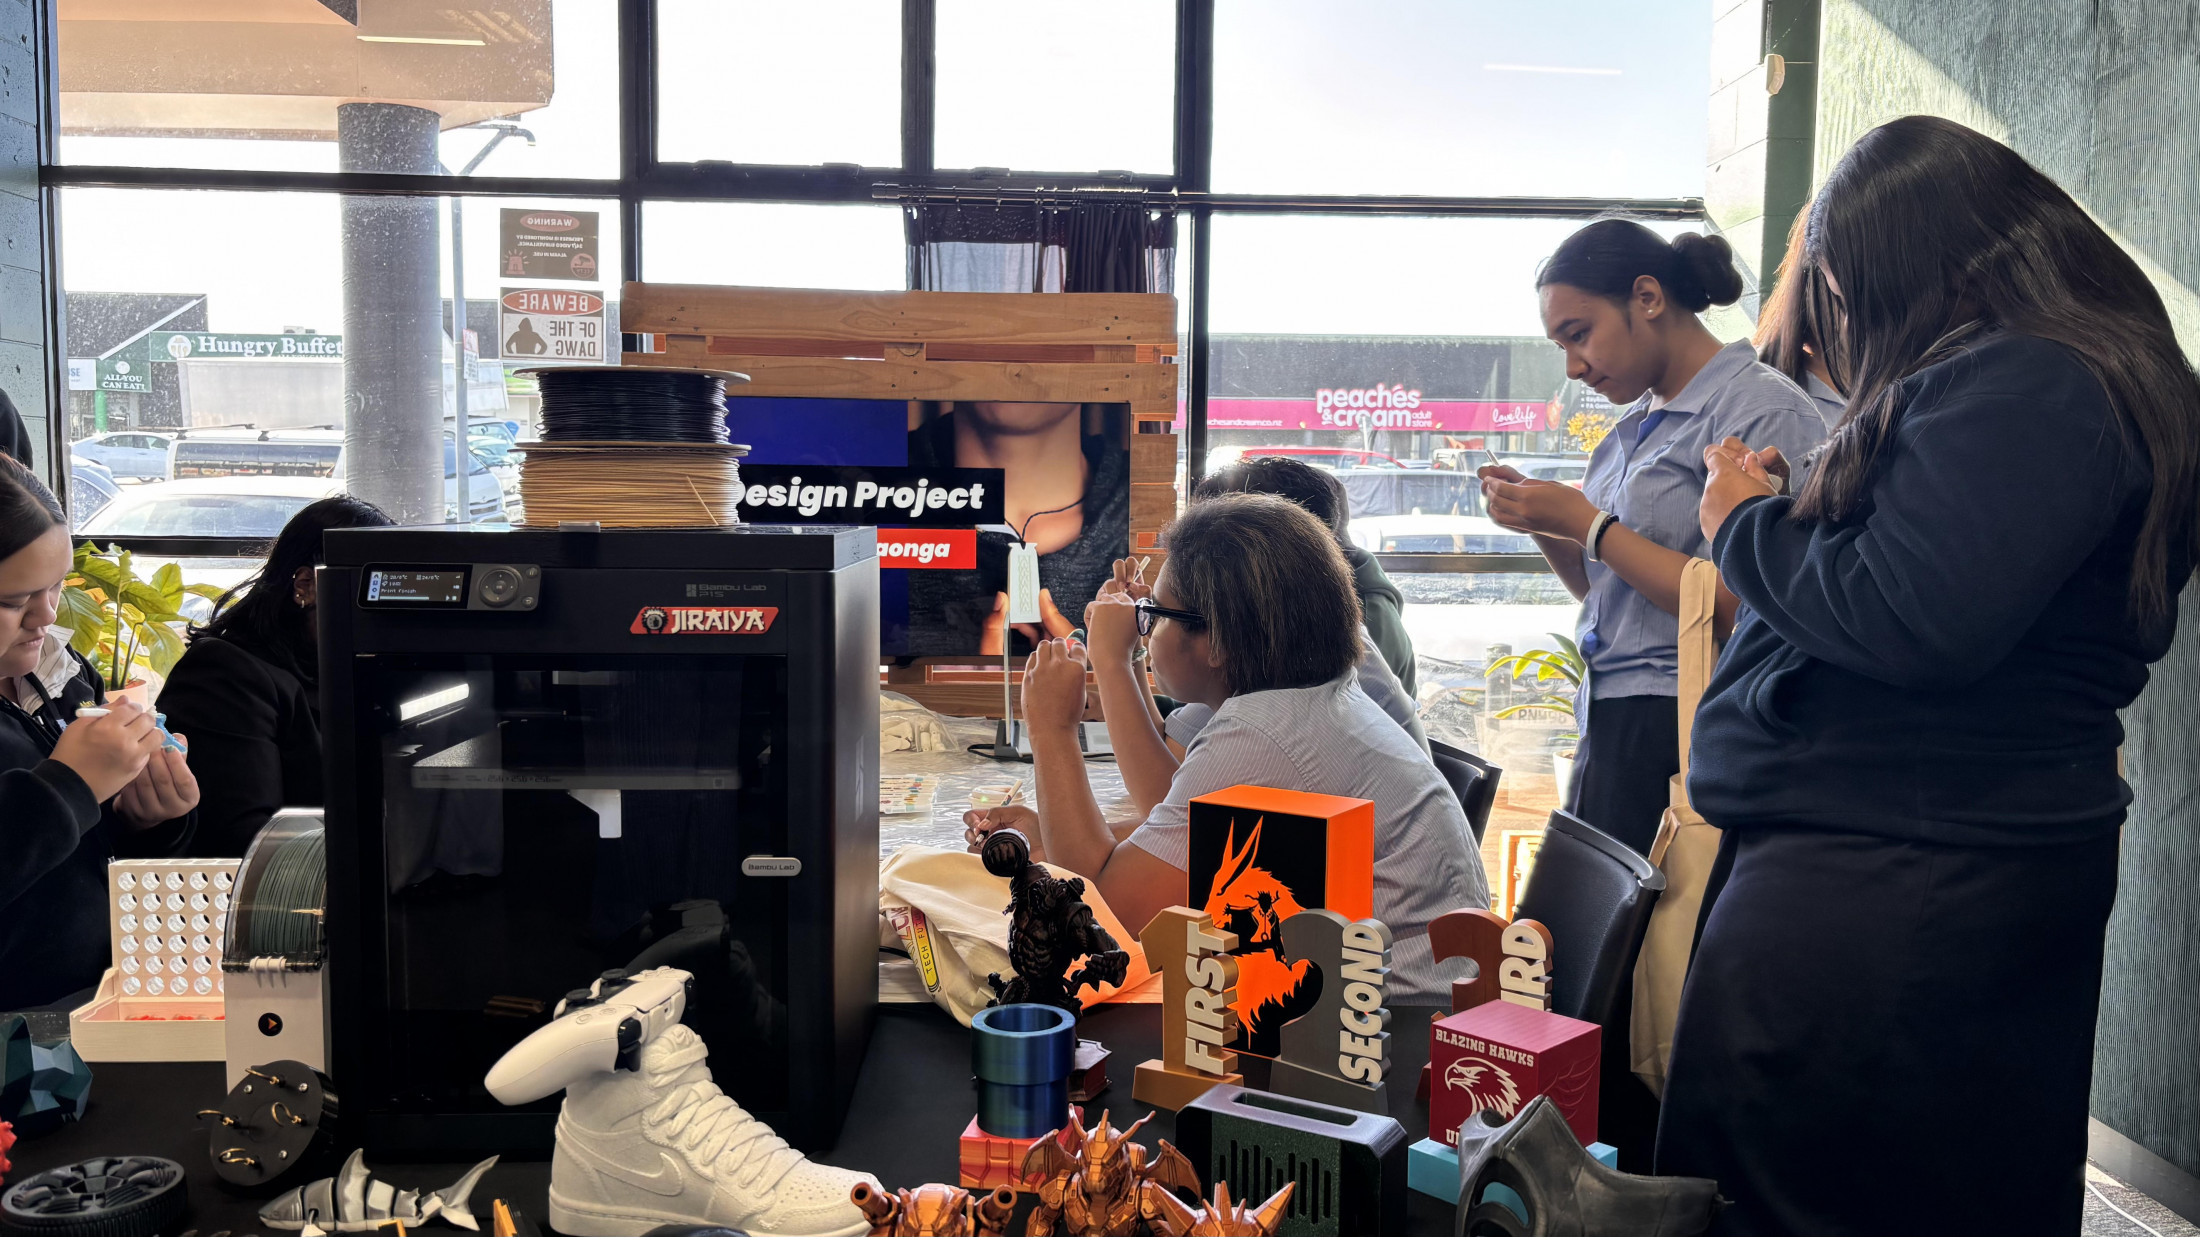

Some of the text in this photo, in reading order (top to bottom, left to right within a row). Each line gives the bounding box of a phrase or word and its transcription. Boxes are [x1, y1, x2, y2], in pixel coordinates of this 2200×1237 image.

[197, 335, 343, 357] Hungry Buffet
[102, 381, 122, 389] CAN
[120, 375, 143, 383] YOU
[1321, 408, 1333, 421] &
[1411, 410, 1433, 419] adult
[1411, 420, 1433, 428] store
[737, 476, 985, 518] esign Project
[876, 542, 951, 564] aonga
[699, 583, 767, 591] Bambu Lab
[671, 608, 766, 634] JIRAIYA
[921, 945, 933, 975] TECH
[1499, 923, 1548, 1012] IRD
[1185, 920, 1228, 1076] FIRST
[1338, 922, 1387, 1084] SECOND
[1435, 1028, 1535, 1068] BLAZING HAWKS
